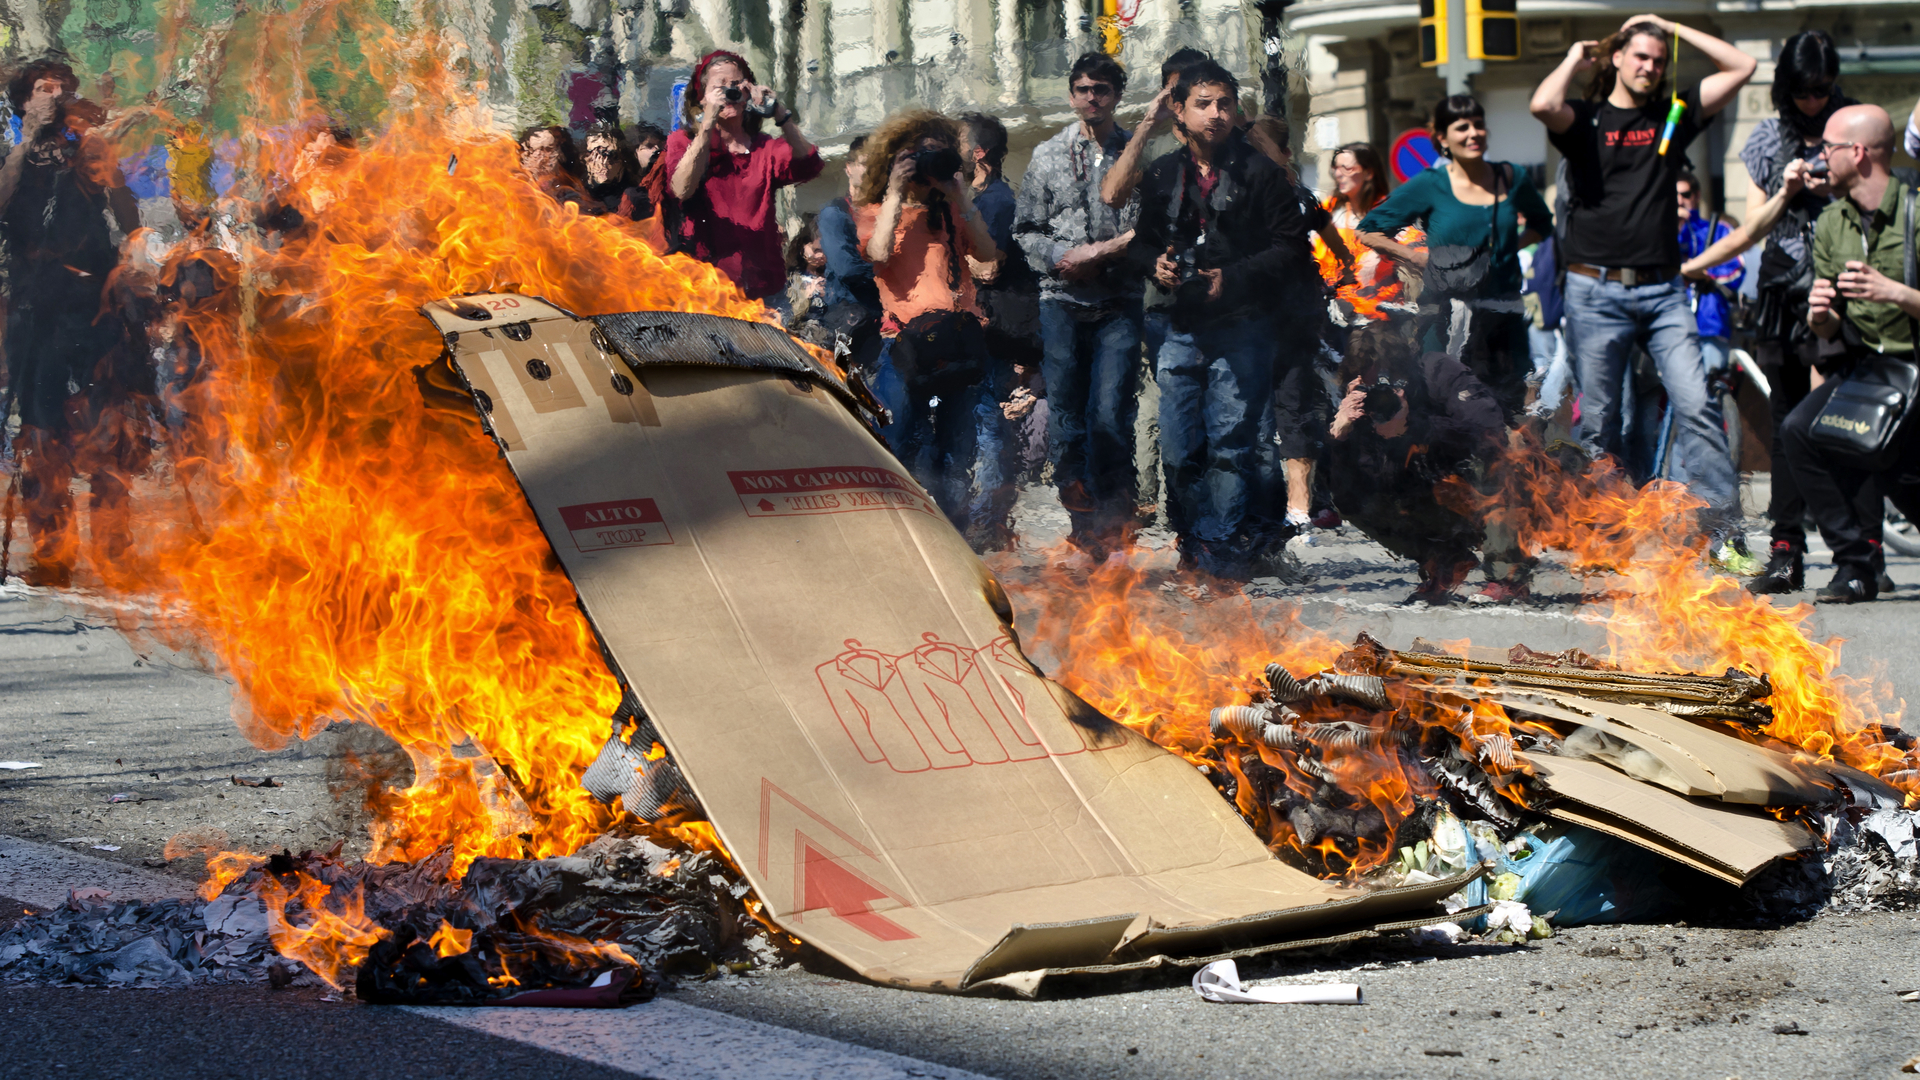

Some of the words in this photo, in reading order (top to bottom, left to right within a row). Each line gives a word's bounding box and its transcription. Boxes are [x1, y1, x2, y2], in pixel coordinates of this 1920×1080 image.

[1820, 414, 1854, 431] adidas
[741, 474, 788, 490] NON
[784, 493, 840, 511] THIS
[841, 491, 887, 507] WAY
[887, 491, 915, 506] UP
[584, 506, 642, 523] ALTO
[596, 528, 646, 545] TOP
